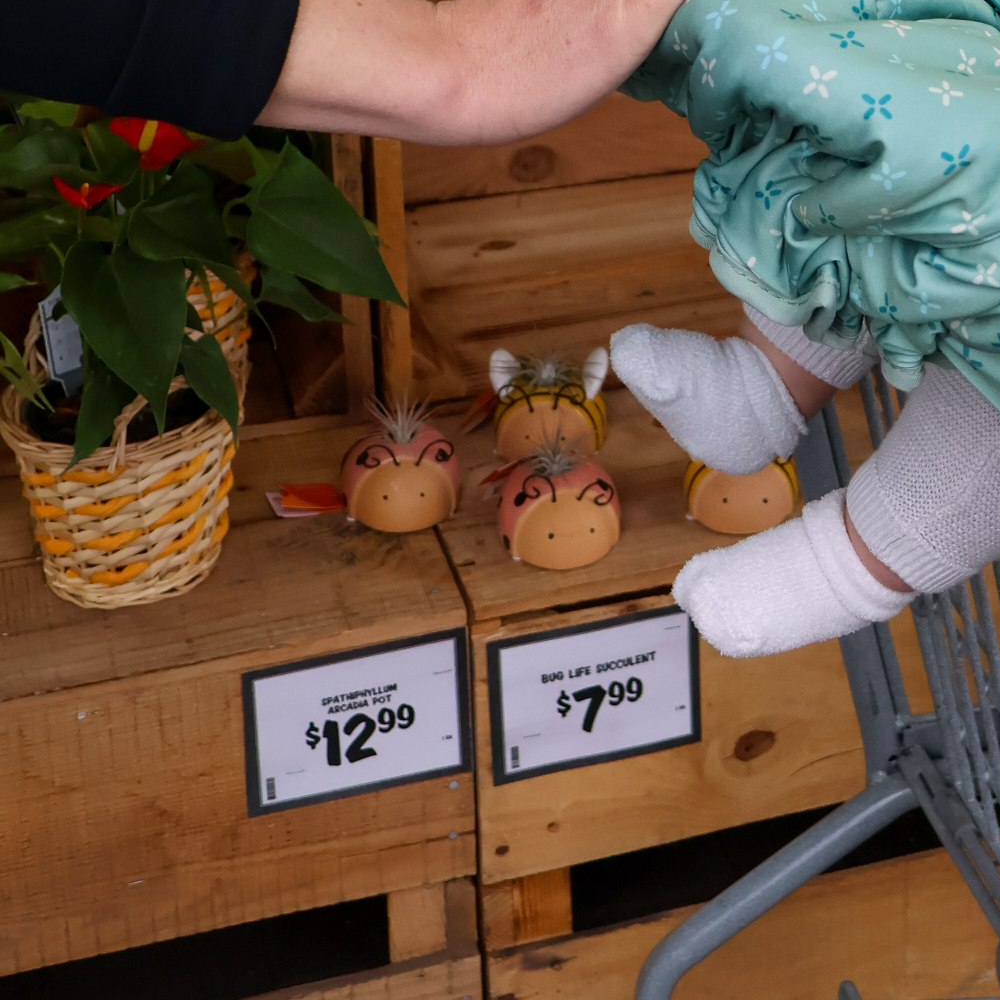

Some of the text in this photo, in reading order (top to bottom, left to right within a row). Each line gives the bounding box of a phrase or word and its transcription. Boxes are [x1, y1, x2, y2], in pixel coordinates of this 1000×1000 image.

[541, 650, 657, 684] BUG LIFE SUCCULENT
[321, 682, 398, 706] SPATHIPHYLLUM
[327, 693, 392, 715] ARCADIA POT
